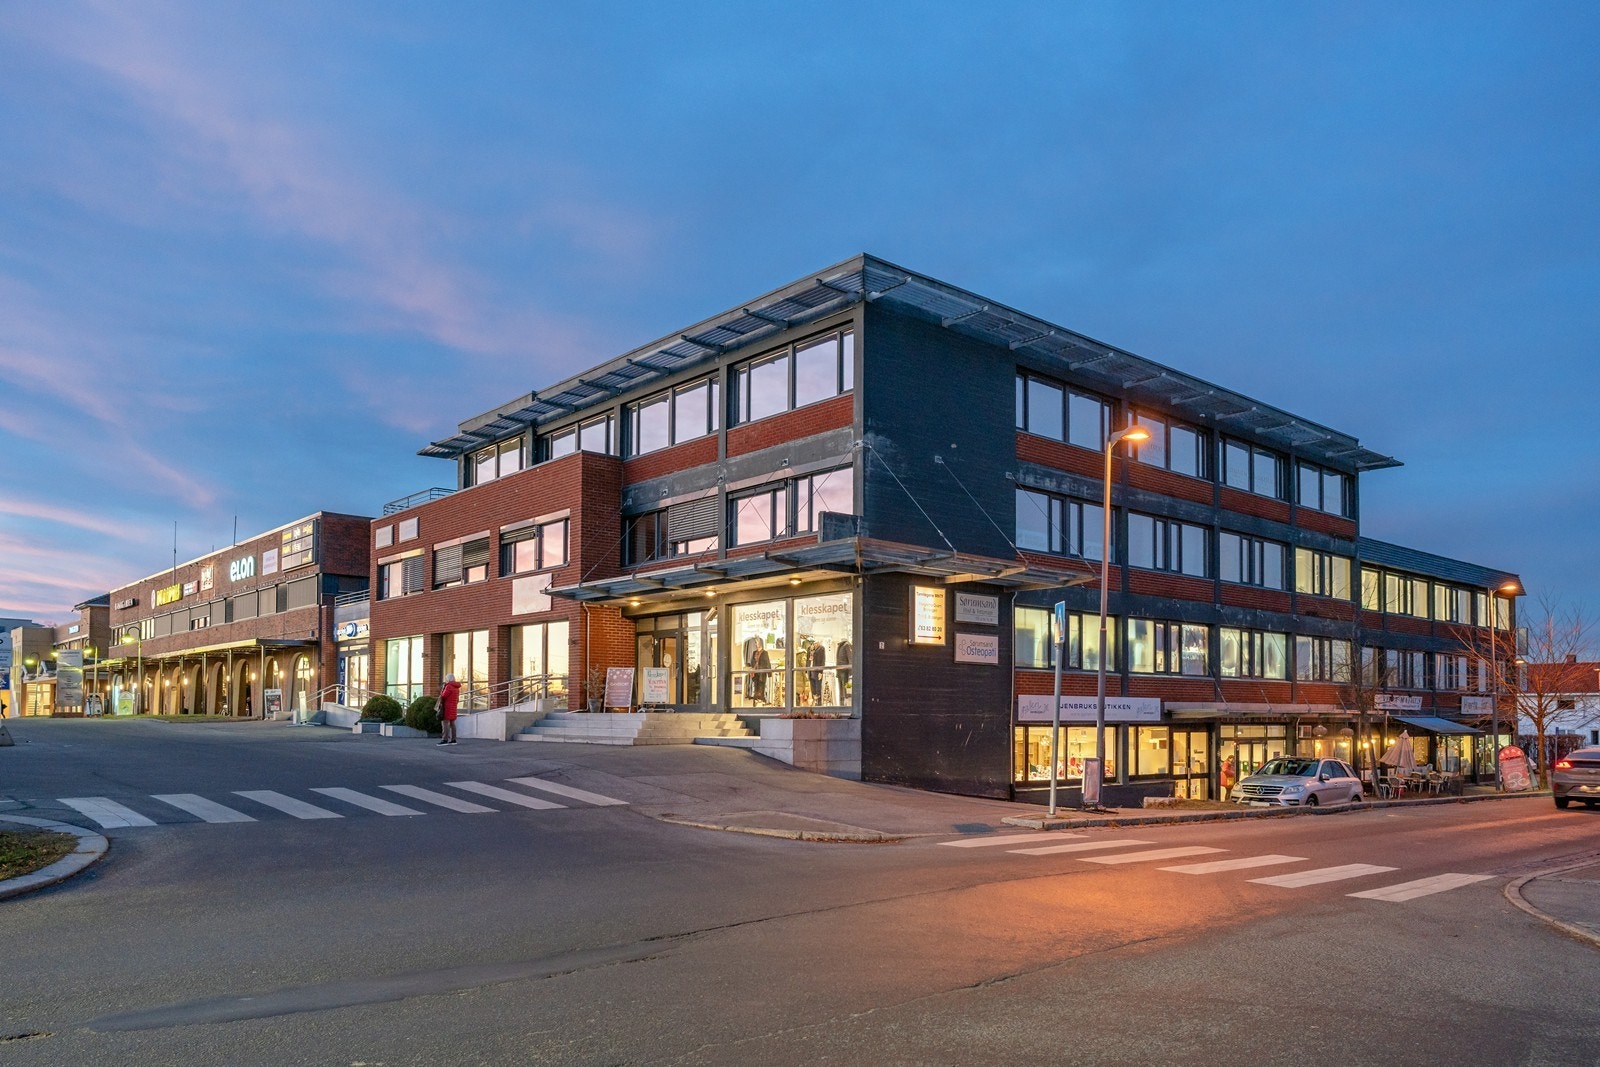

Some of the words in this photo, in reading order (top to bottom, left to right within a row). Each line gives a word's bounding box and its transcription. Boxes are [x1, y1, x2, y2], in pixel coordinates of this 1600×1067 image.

[801, 603, 848, 615] klesskapet
[738, 609, 779, 622] klesskapet
[966, 646, 997, 658] Osteopati
